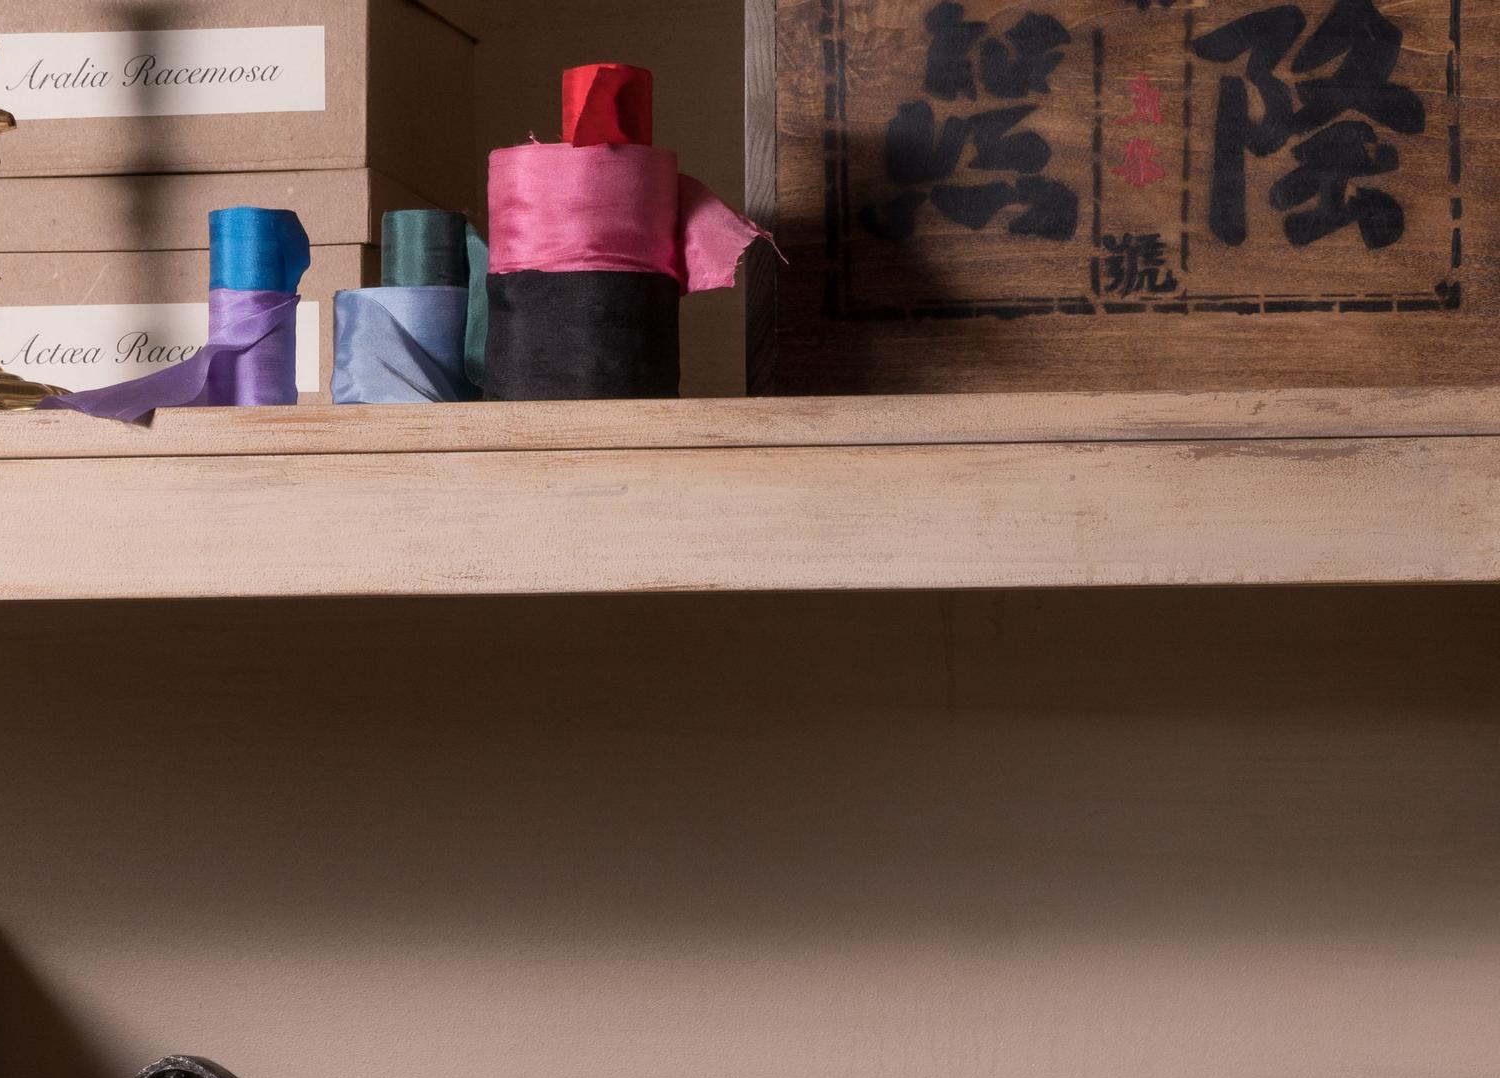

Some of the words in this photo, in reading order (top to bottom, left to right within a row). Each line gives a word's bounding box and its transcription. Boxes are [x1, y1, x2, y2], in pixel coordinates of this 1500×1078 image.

[5, 57, 112, 91] Aralia
[122, 54, 283, 88] Racemosa
[114, 331, 202, 364] Race
